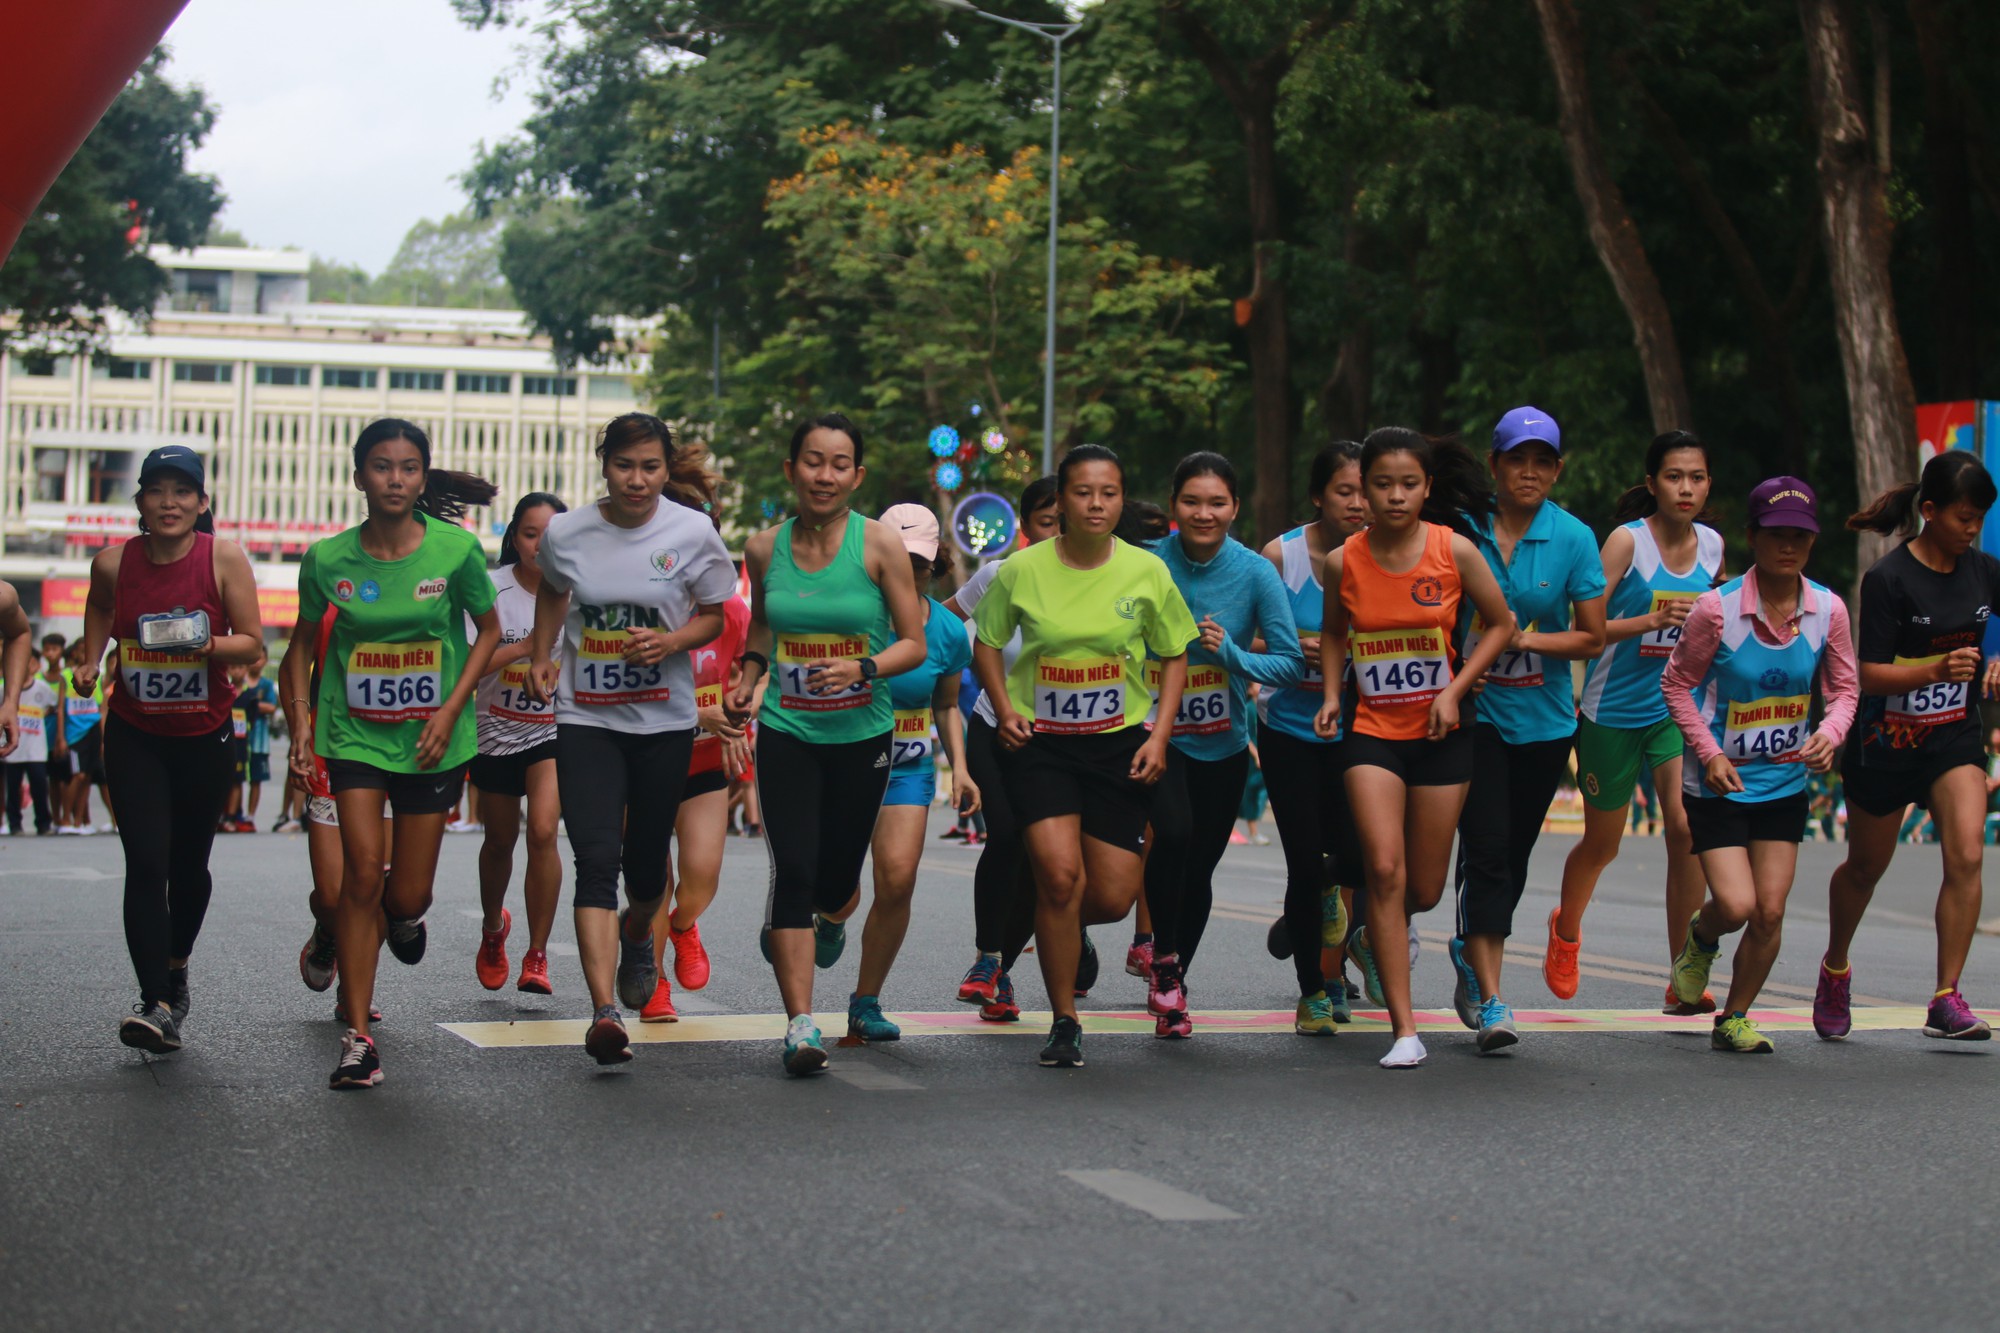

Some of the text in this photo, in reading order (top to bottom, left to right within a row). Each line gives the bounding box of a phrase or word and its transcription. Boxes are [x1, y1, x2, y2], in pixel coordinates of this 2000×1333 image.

[1769, 490, 1810, 504] PACIFIC TRAVEL
[419, 584, 445, 596] MILO
[583, 636, 624, 654] THANH
[784, 639, 863, 658] THANH NIÊN
[1357, 635, 1439, 656] THANH NIÊN
[356, 648, 434, 669] THANH NIÊN
[583, 663, 662, 690] 1553
[1040, 663, 1120, 683] THANH NIÊN
[1191, 670, 1223, 688] NIÊN
[1365, 661, 1442, 692] 1467
[129, 671, 203, 699] 1524
[357, 675, 435, 707] 1566
[696, 693, 717, 708] IÊN
[1044, 689, 1120, 719] 1473
[1897, 681, 1962, 712] 1552
[1153, 693, 1224, 722] 466
[1733, 702, 1804, 725] THANH NIÊN
[902, 715, 925, 732] NIÊN
[1733, 725, 1799, 757] 1468
